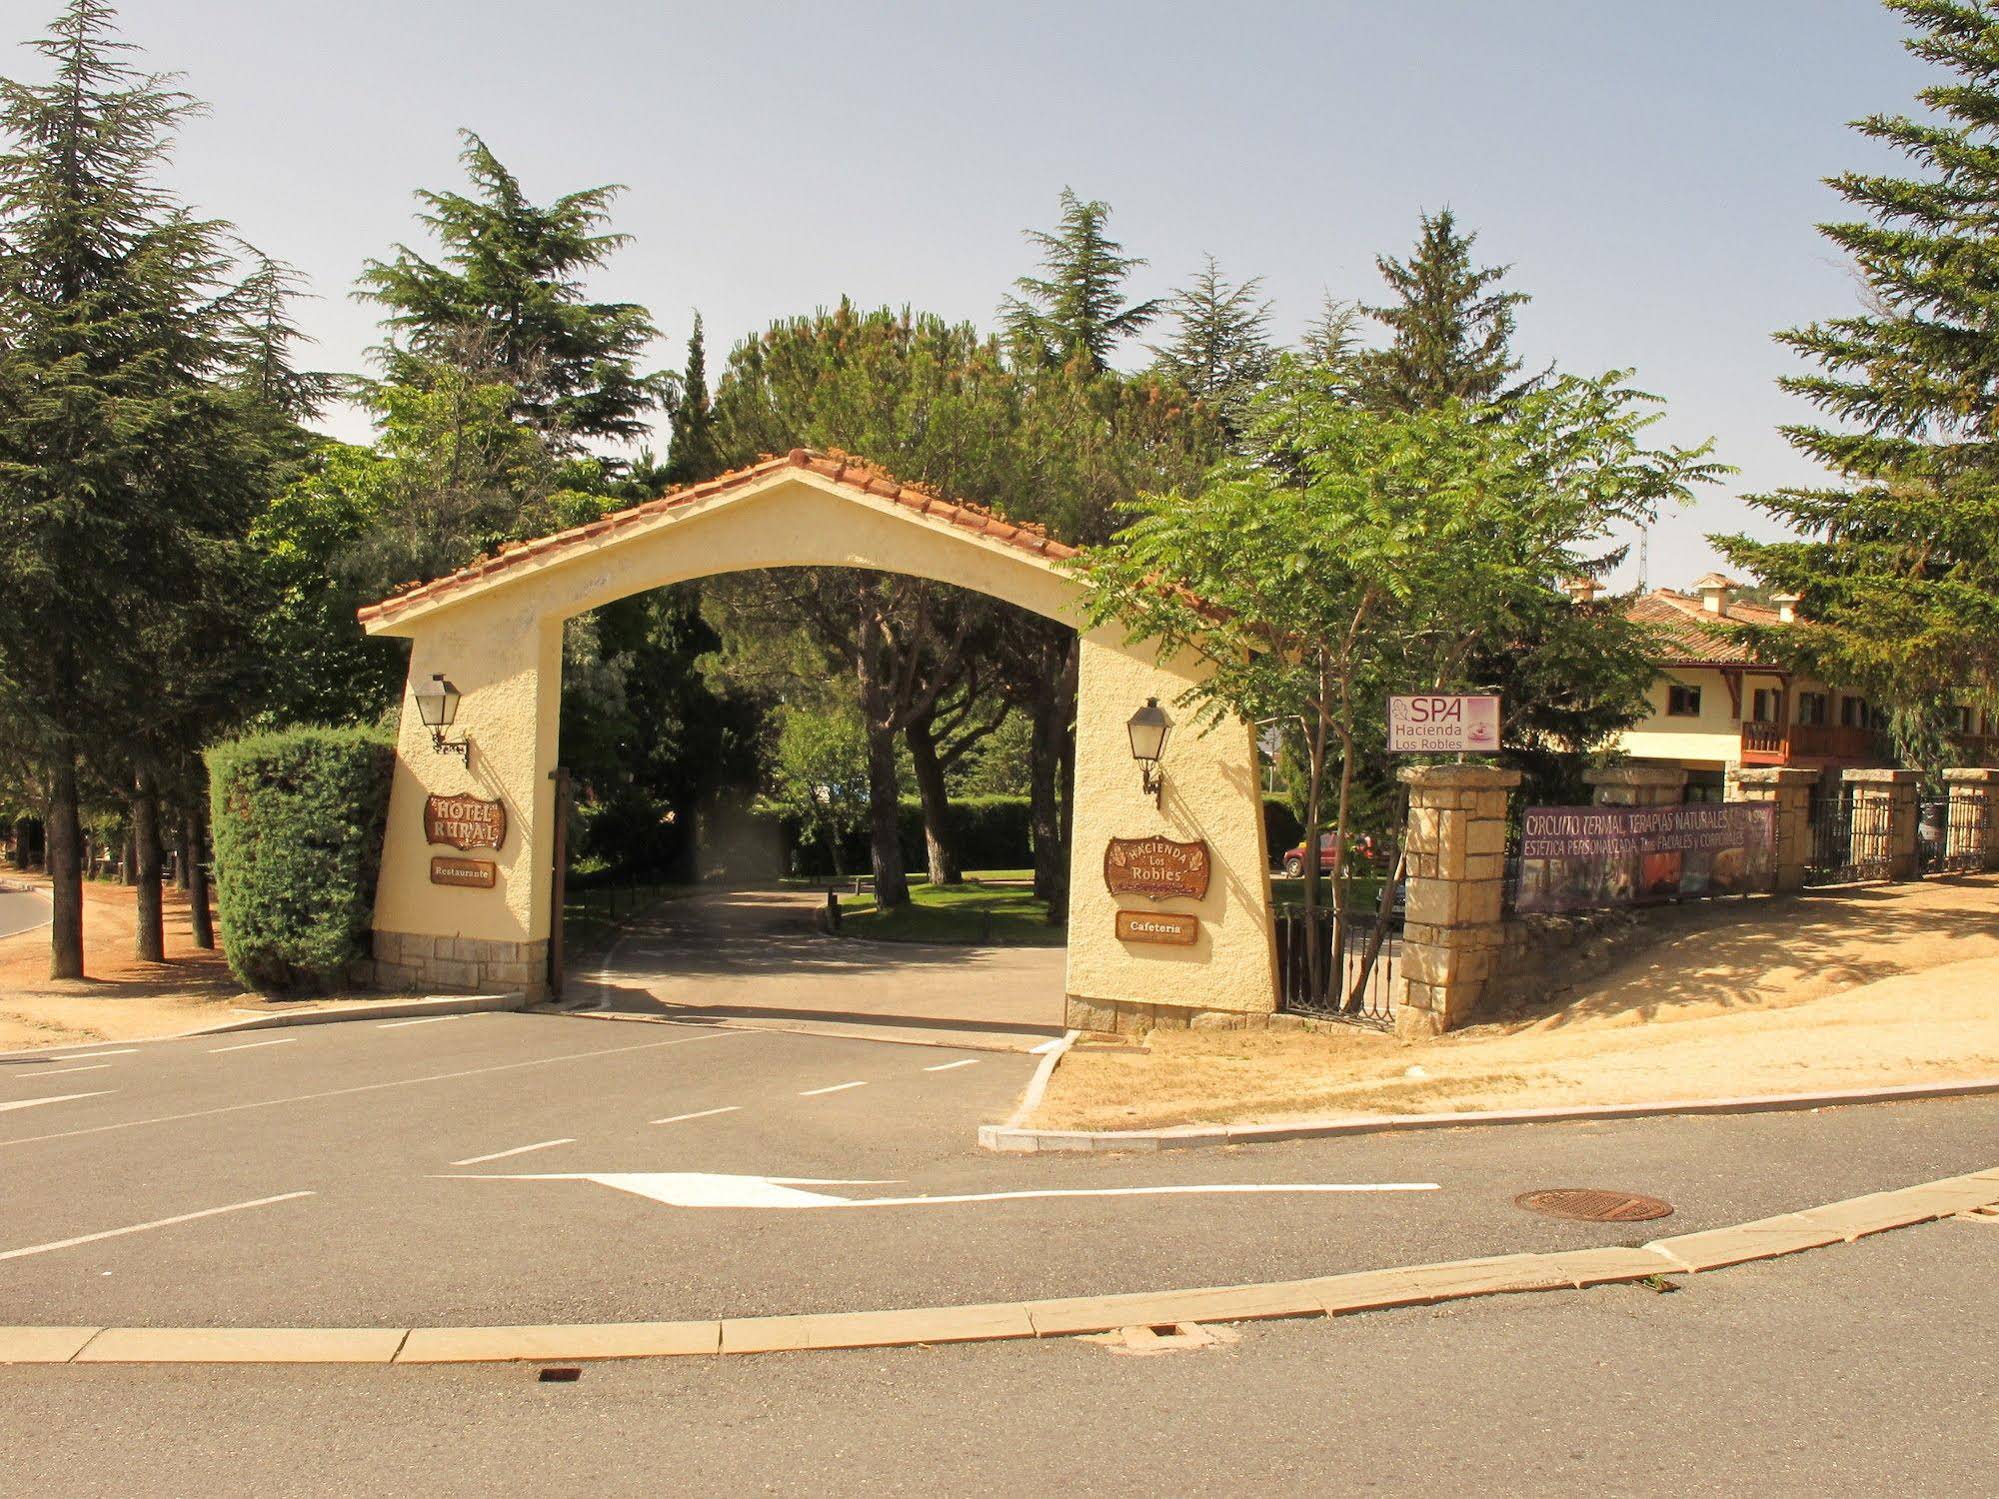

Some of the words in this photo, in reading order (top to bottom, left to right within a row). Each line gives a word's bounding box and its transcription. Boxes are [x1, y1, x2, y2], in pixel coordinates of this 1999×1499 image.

[1411, 698, 1461, 722] SPA
[1395, 724, 1462, 736] Hacienda
[1395, 739, 1417, 750] Los
[1421, 738, 1462, 750] Robles
[438, 800, 491, 822] HOTEL
[434, 821, 496, 841] RURAL
[1525, 815, 1580, 836] CIRCUITO
[1629, 812, 1674, 834] TERAPIAS
[1675, 809, 1729, 831] NATURALES
[1128, 842, 1187, 863] HACIENDA
[1149, 856, 1165, 866] Los
[436, 866, 489, 879] Restaurante
[1132, 866, 1181, 881] Robles
